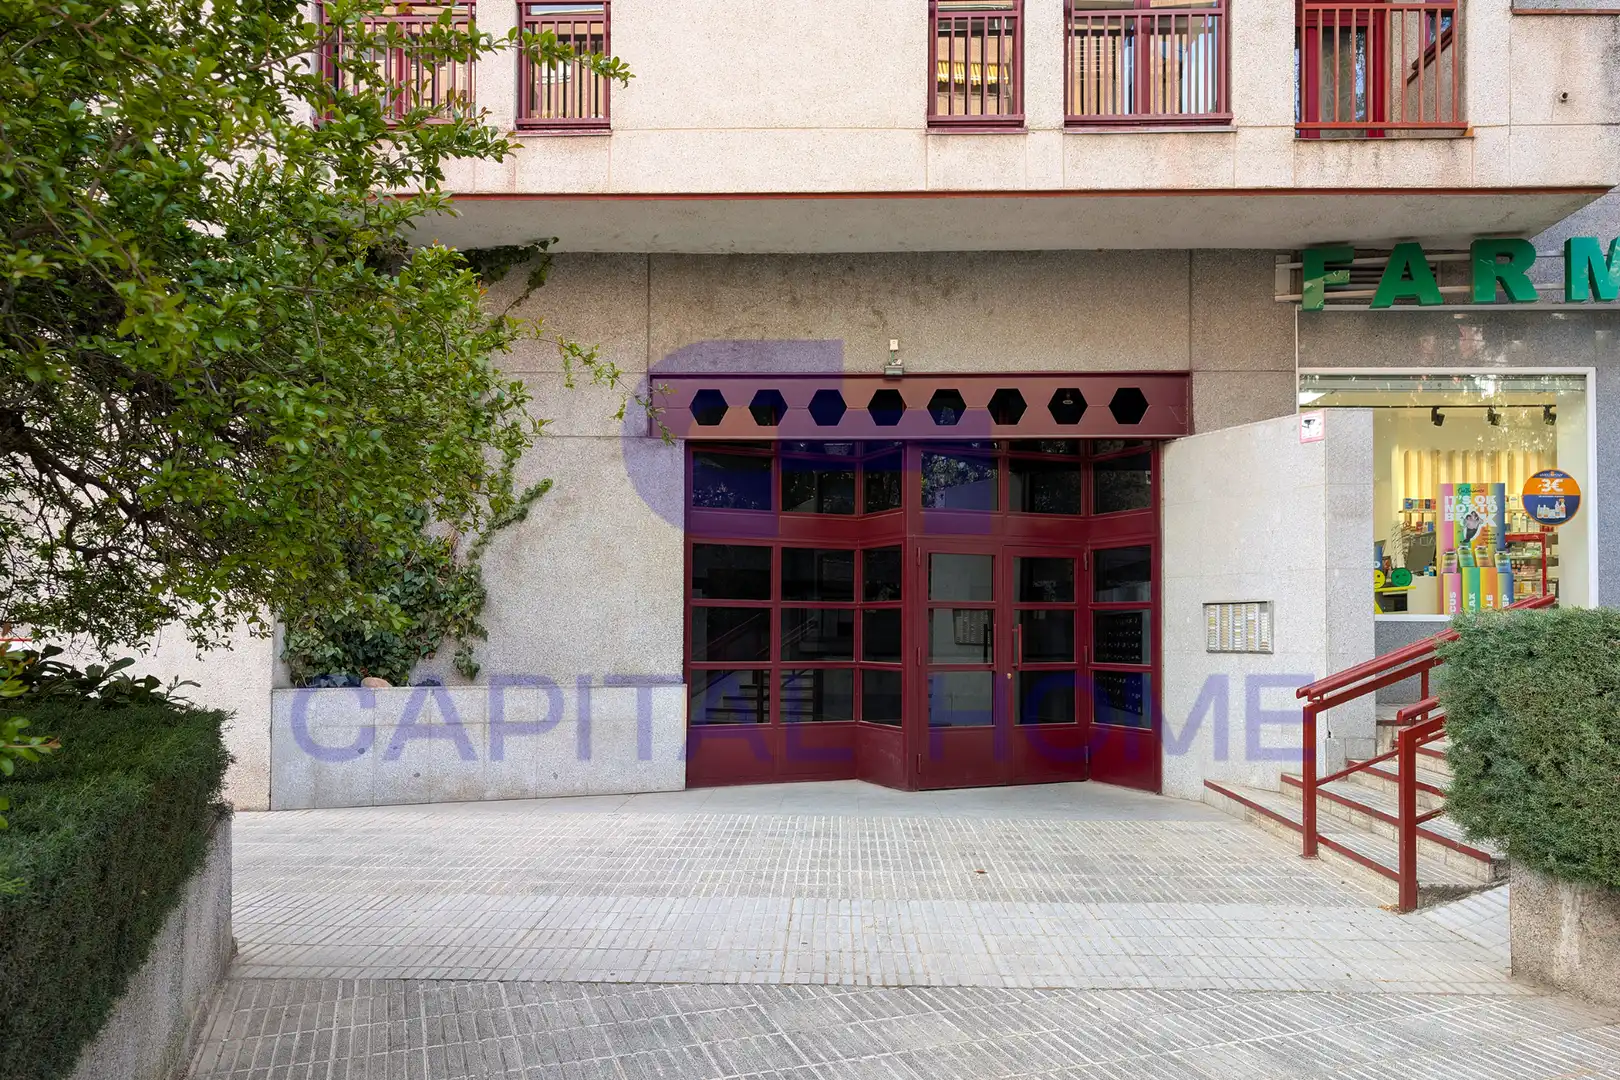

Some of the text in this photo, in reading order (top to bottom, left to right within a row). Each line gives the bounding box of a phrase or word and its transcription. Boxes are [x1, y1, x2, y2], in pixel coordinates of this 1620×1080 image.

[1445, 495, 1497, 504] IT'S OK
[1445, 504, 1498, 512] NOT TO
